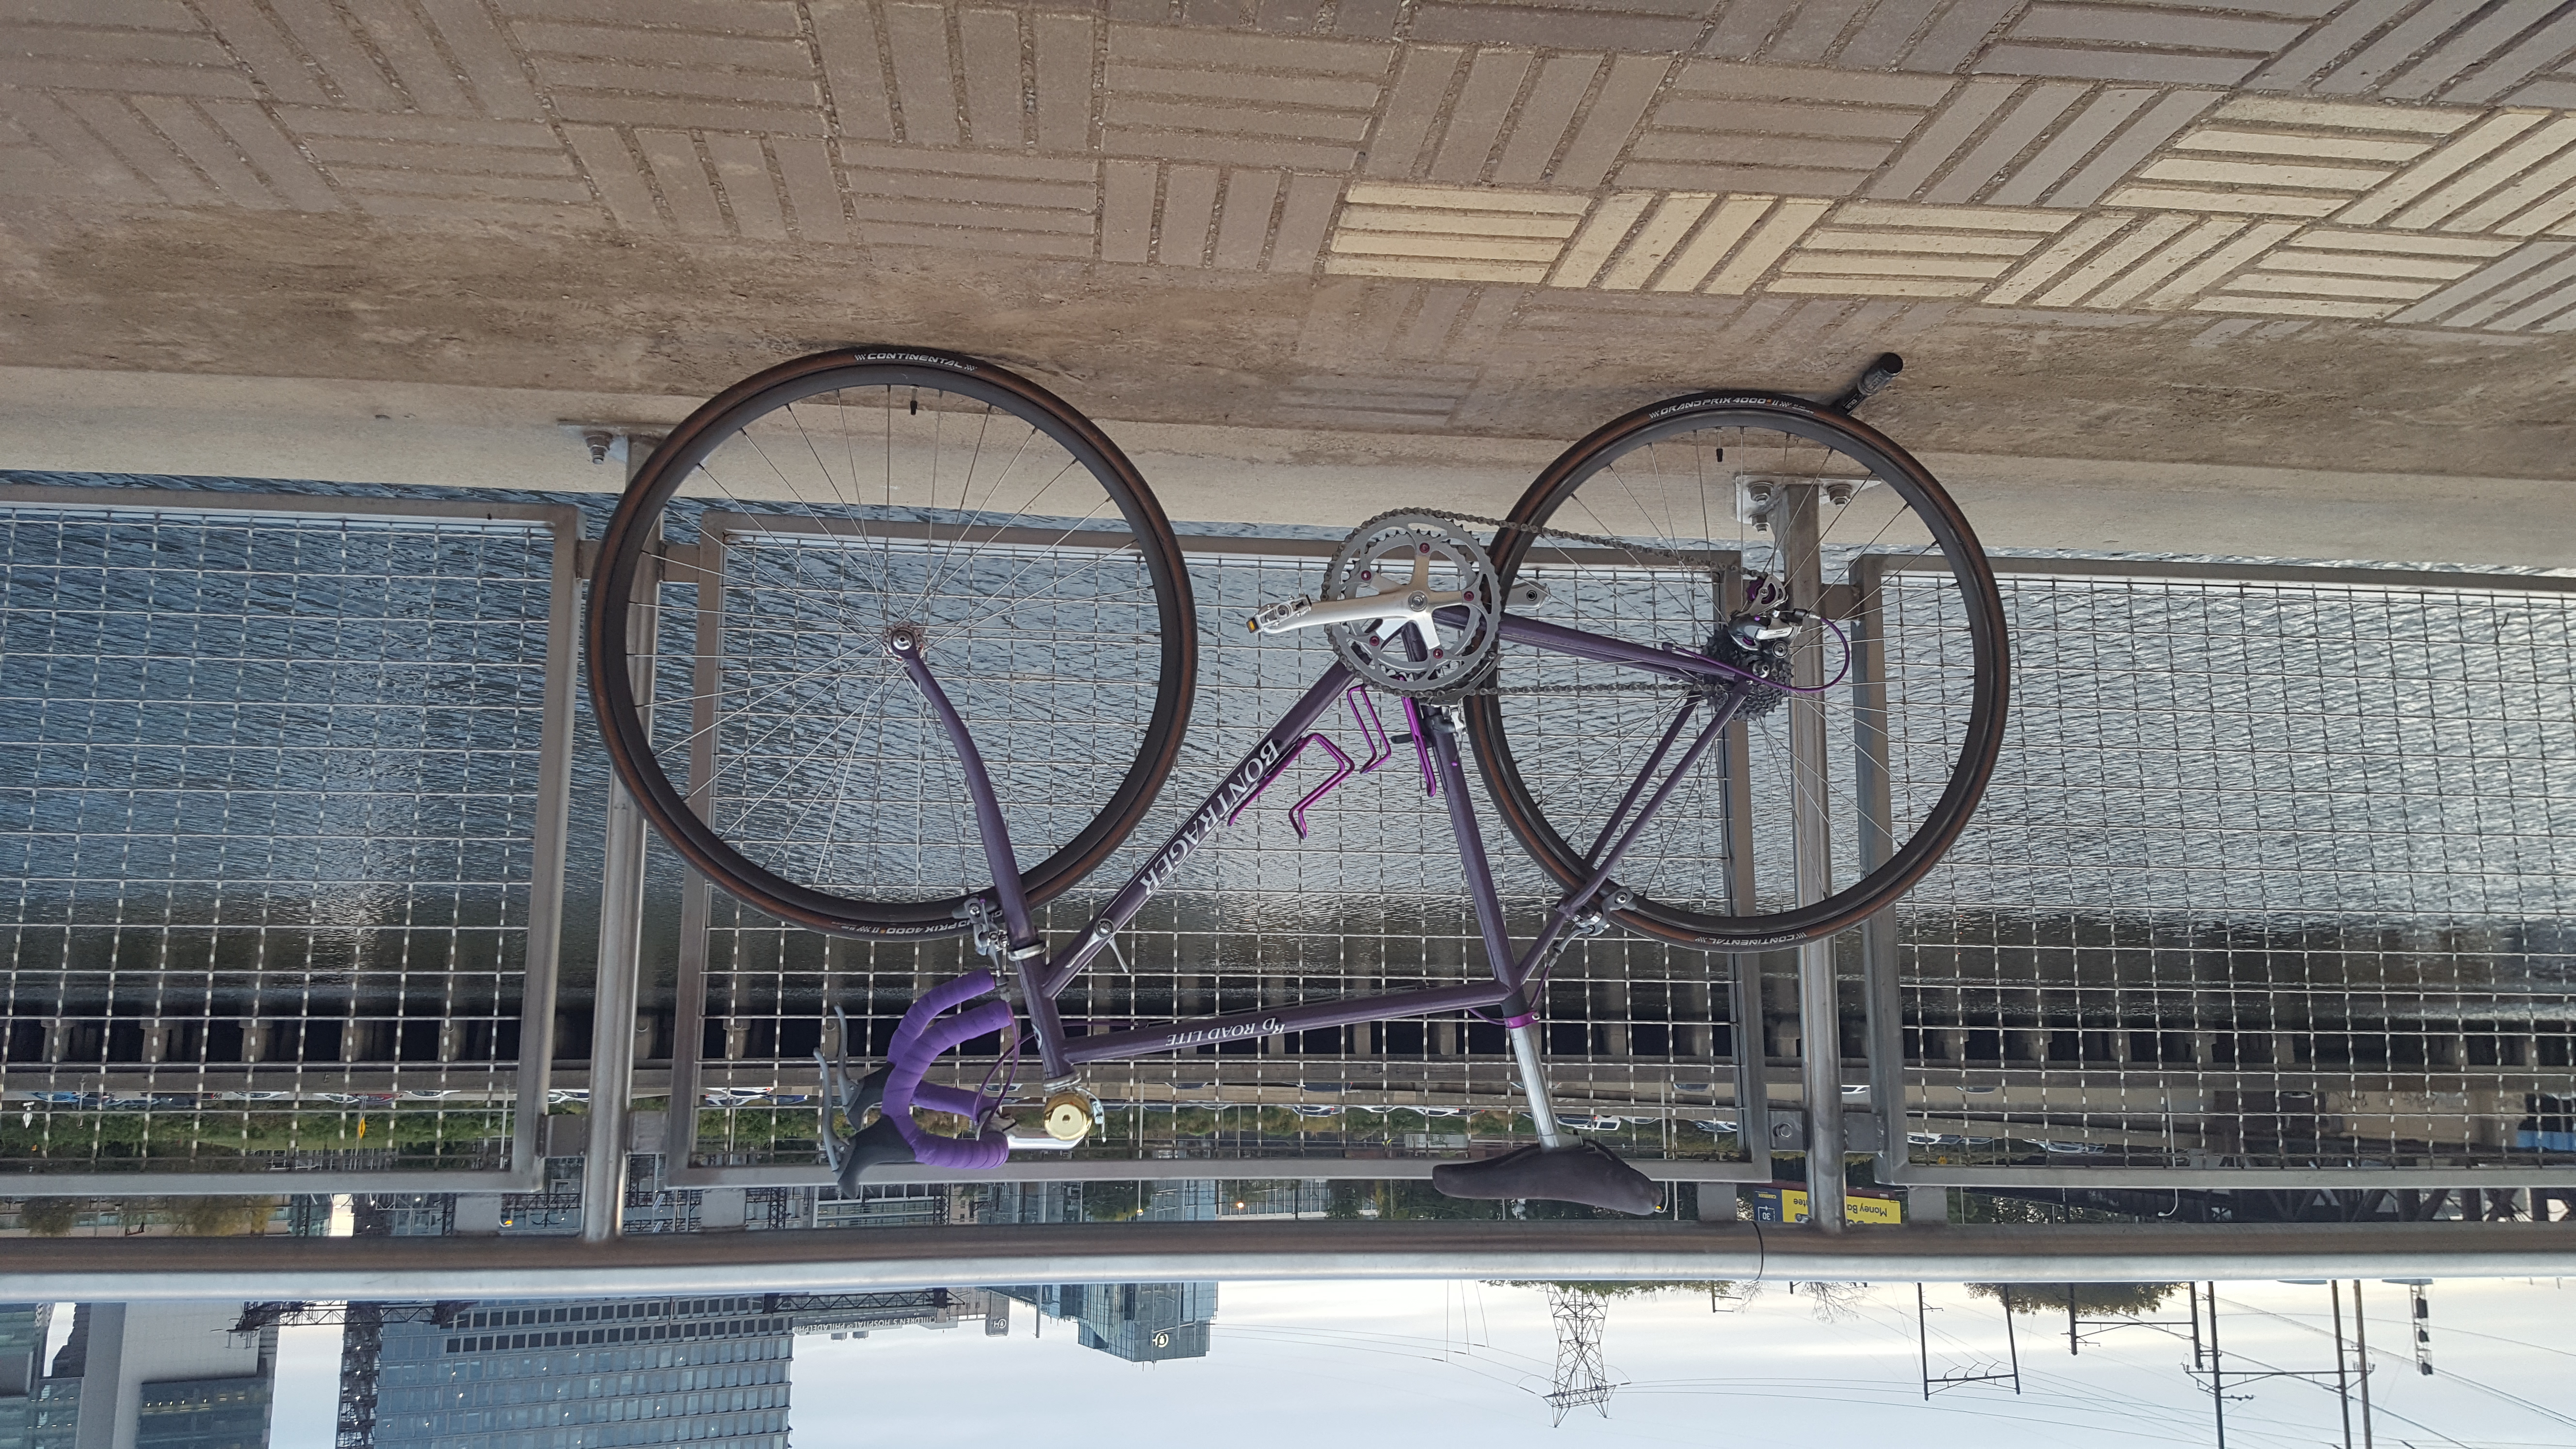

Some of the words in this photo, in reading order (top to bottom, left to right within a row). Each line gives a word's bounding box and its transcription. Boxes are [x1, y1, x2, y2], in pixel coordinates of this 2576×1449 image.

[867, 353, 963, 369] CONTINENTAL
[1660, 401, 1701, 415] GRAND
[1700, 397, 1731, 405] PRIX
[1140, 738, 1280, 896] BONTRAGER
[924, 923, 956, 933] PRIX
[1709, 934, 1795, 946] CONTINENTAL
[1165, 1030, 1203, 1046] LITE
[1208, 1023, 1256, 1039] ROAD
[1762, 1212, 1771, 1221] 30
[1859, 1203, 1887, 1218] Money
[854, 1319, 890, 1329] HOSPITAL
[893, 1316, 936, 1326] CHILDREN'S
